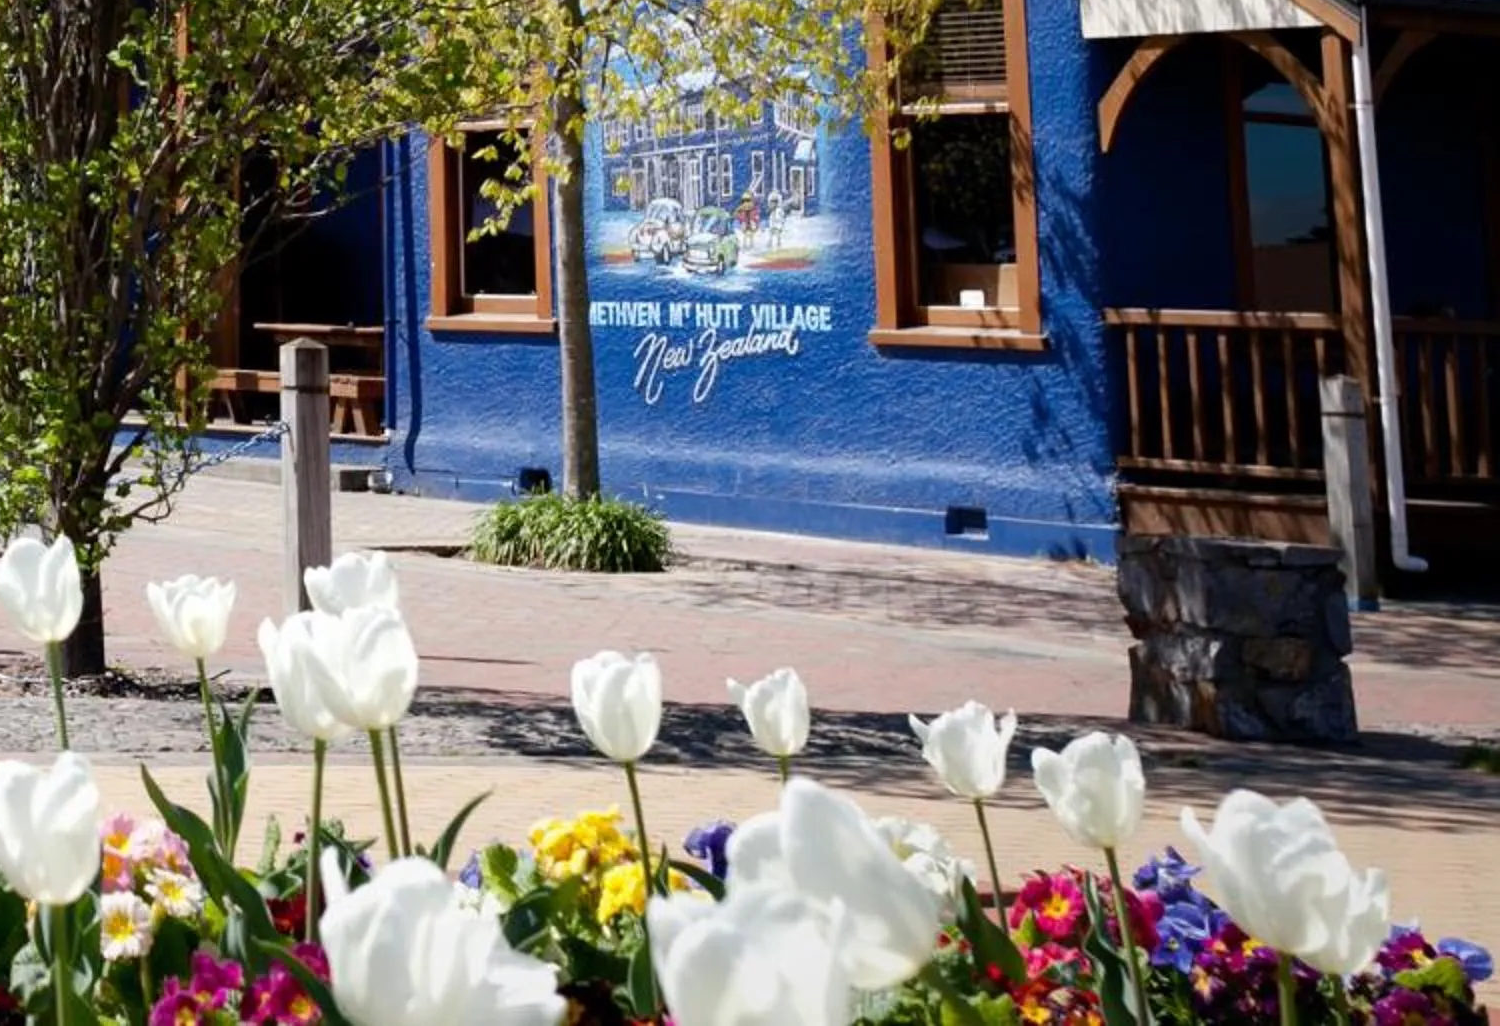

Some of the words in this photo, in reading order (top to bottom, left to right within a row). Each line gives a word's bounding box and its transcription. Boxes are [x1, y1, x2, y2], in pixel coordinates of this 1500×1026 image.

[695, 303, 742, 328] HUTT
[750, 305, 832, 331] VILLAGE
[634, 332, 693, 404] New
[693, 326, 799, 403] Zealand
